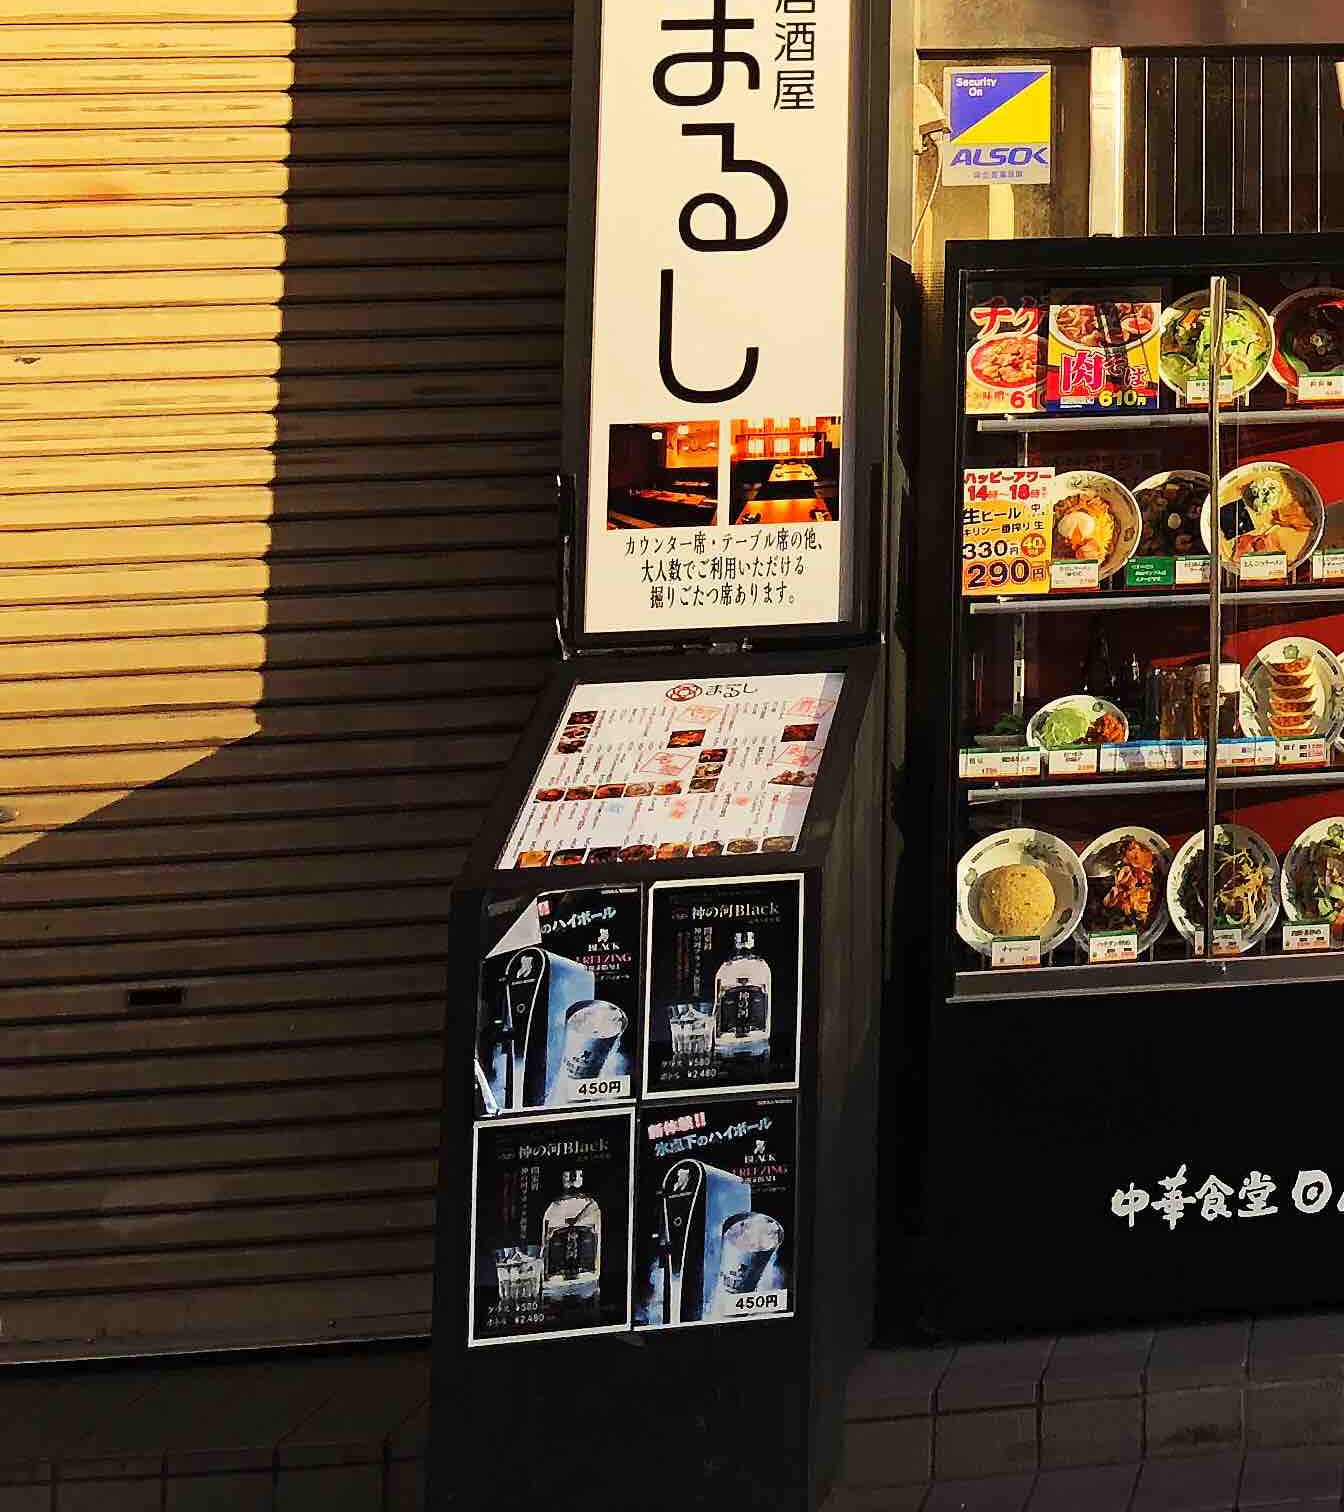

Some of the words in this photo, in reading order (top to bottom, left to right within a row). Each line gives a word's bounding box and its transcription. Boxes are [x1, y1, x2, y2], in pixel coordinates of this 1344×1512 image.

[956, 76, 998, 88] Security
[968, 88, 983, 97] On
[950, 147, 1049, 167] ALSOK
[1060, 350, 1149, 394] 肉そば
[641, 554, 806, 583] 大人数でご利用いただける
[650, 581, 796, 609] 掘りごたつ席あります。
[578, 1079, 621, 1096] 450円
[1110, 1164, 1278, 1231] 中華食堂
[735, 1295, 778, 1311] 450円
